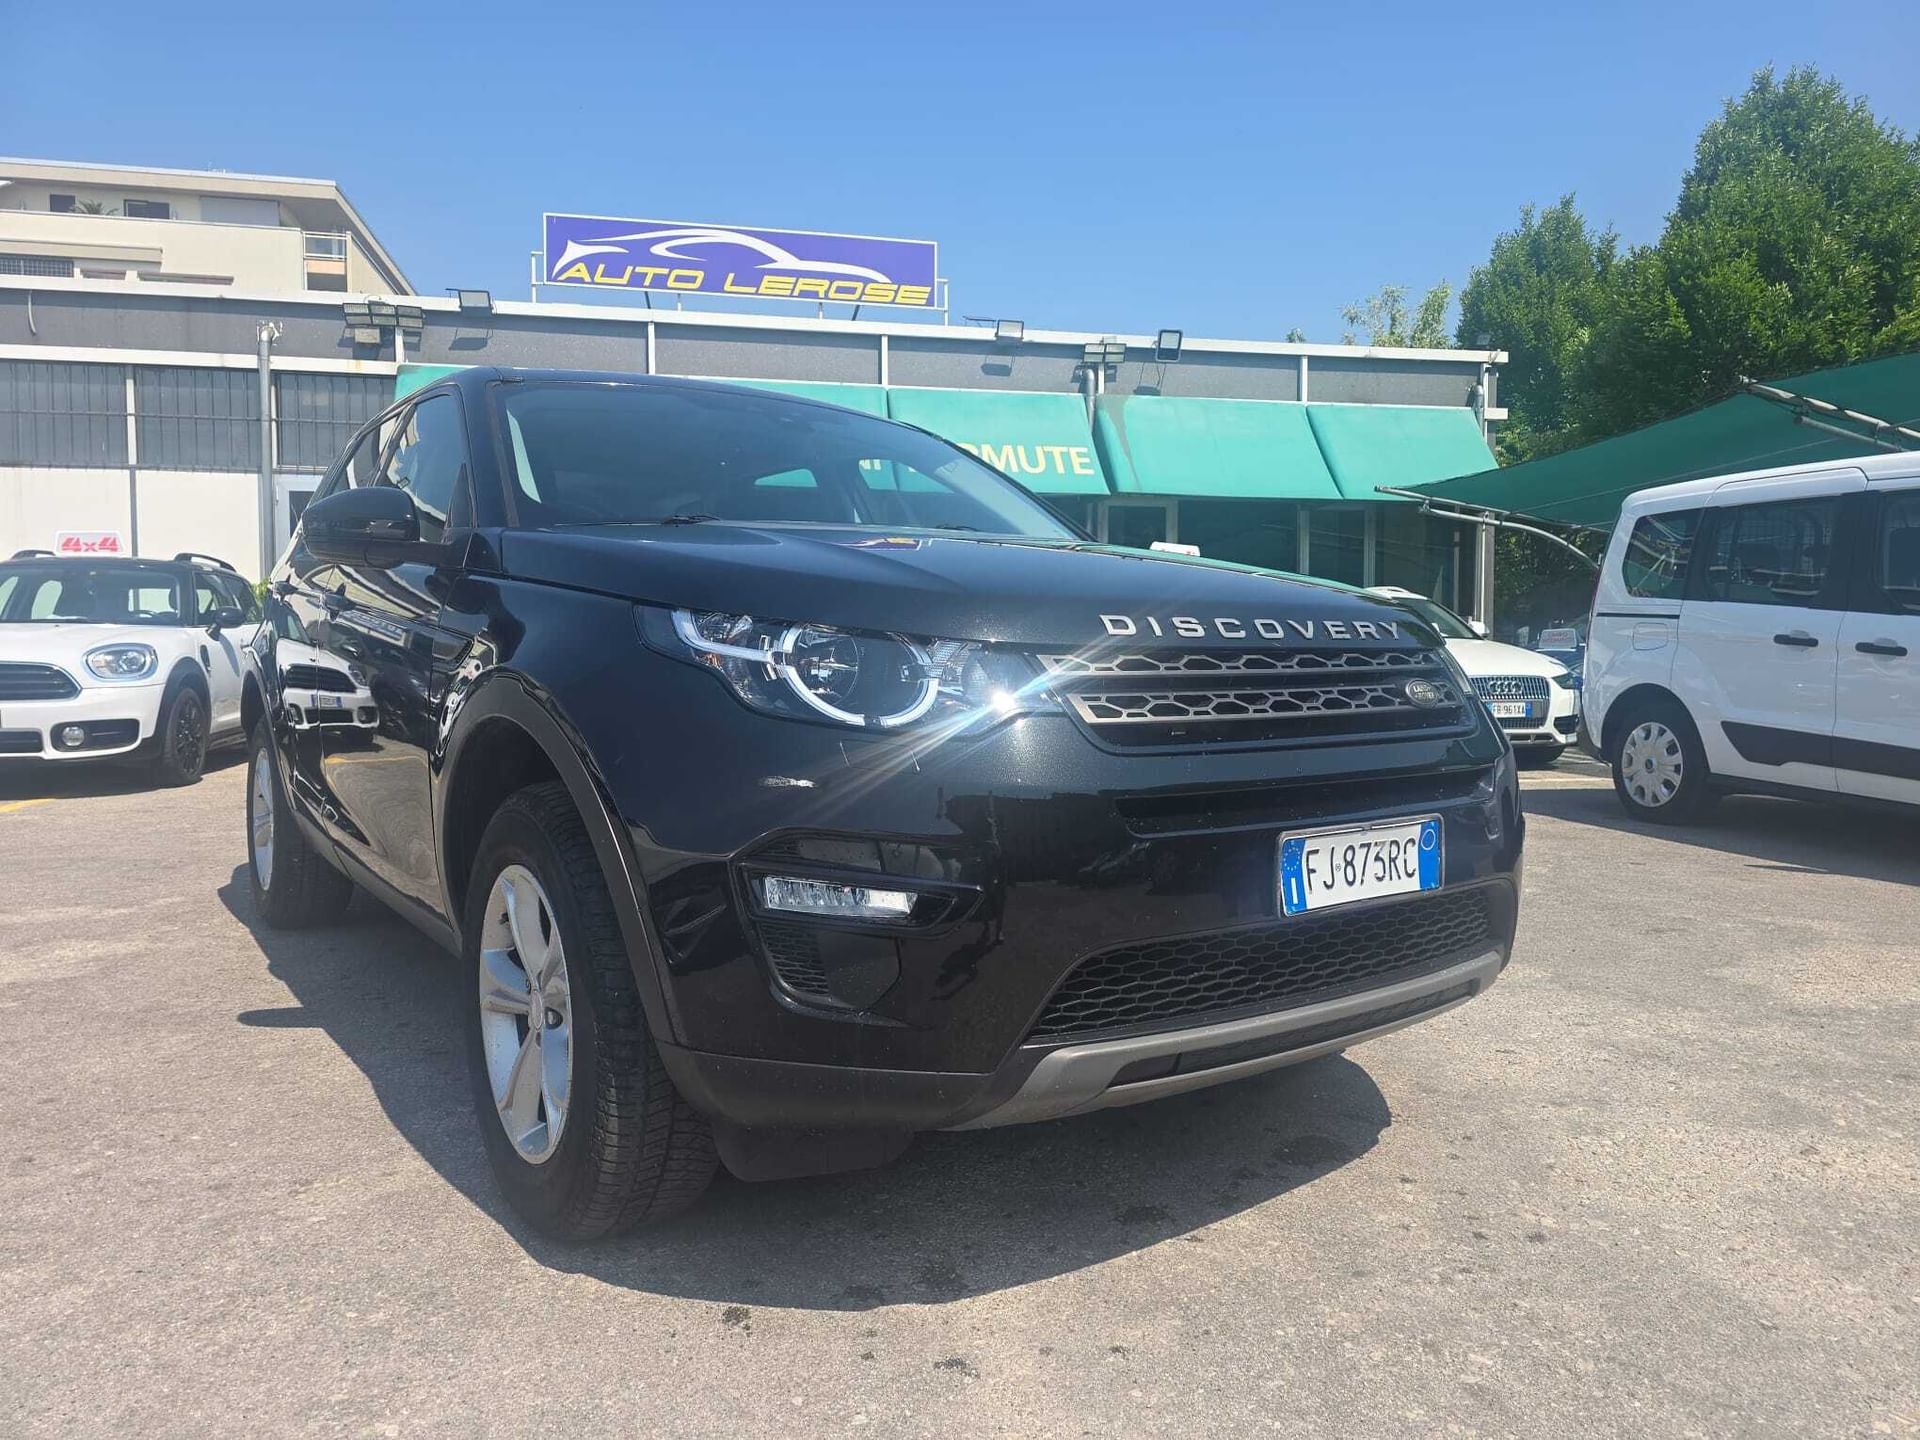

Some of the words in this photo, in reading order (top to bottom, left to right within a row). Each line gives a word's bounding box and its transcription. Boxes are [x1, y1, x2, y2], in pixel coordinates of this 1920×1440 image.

[556, 262, 704, 289] AUTO
[723, 273, 931, 305] LEROSE
[62, 536, 118, 552] 4x4
[1100, 614, 1399, 640] DISCOVERY
